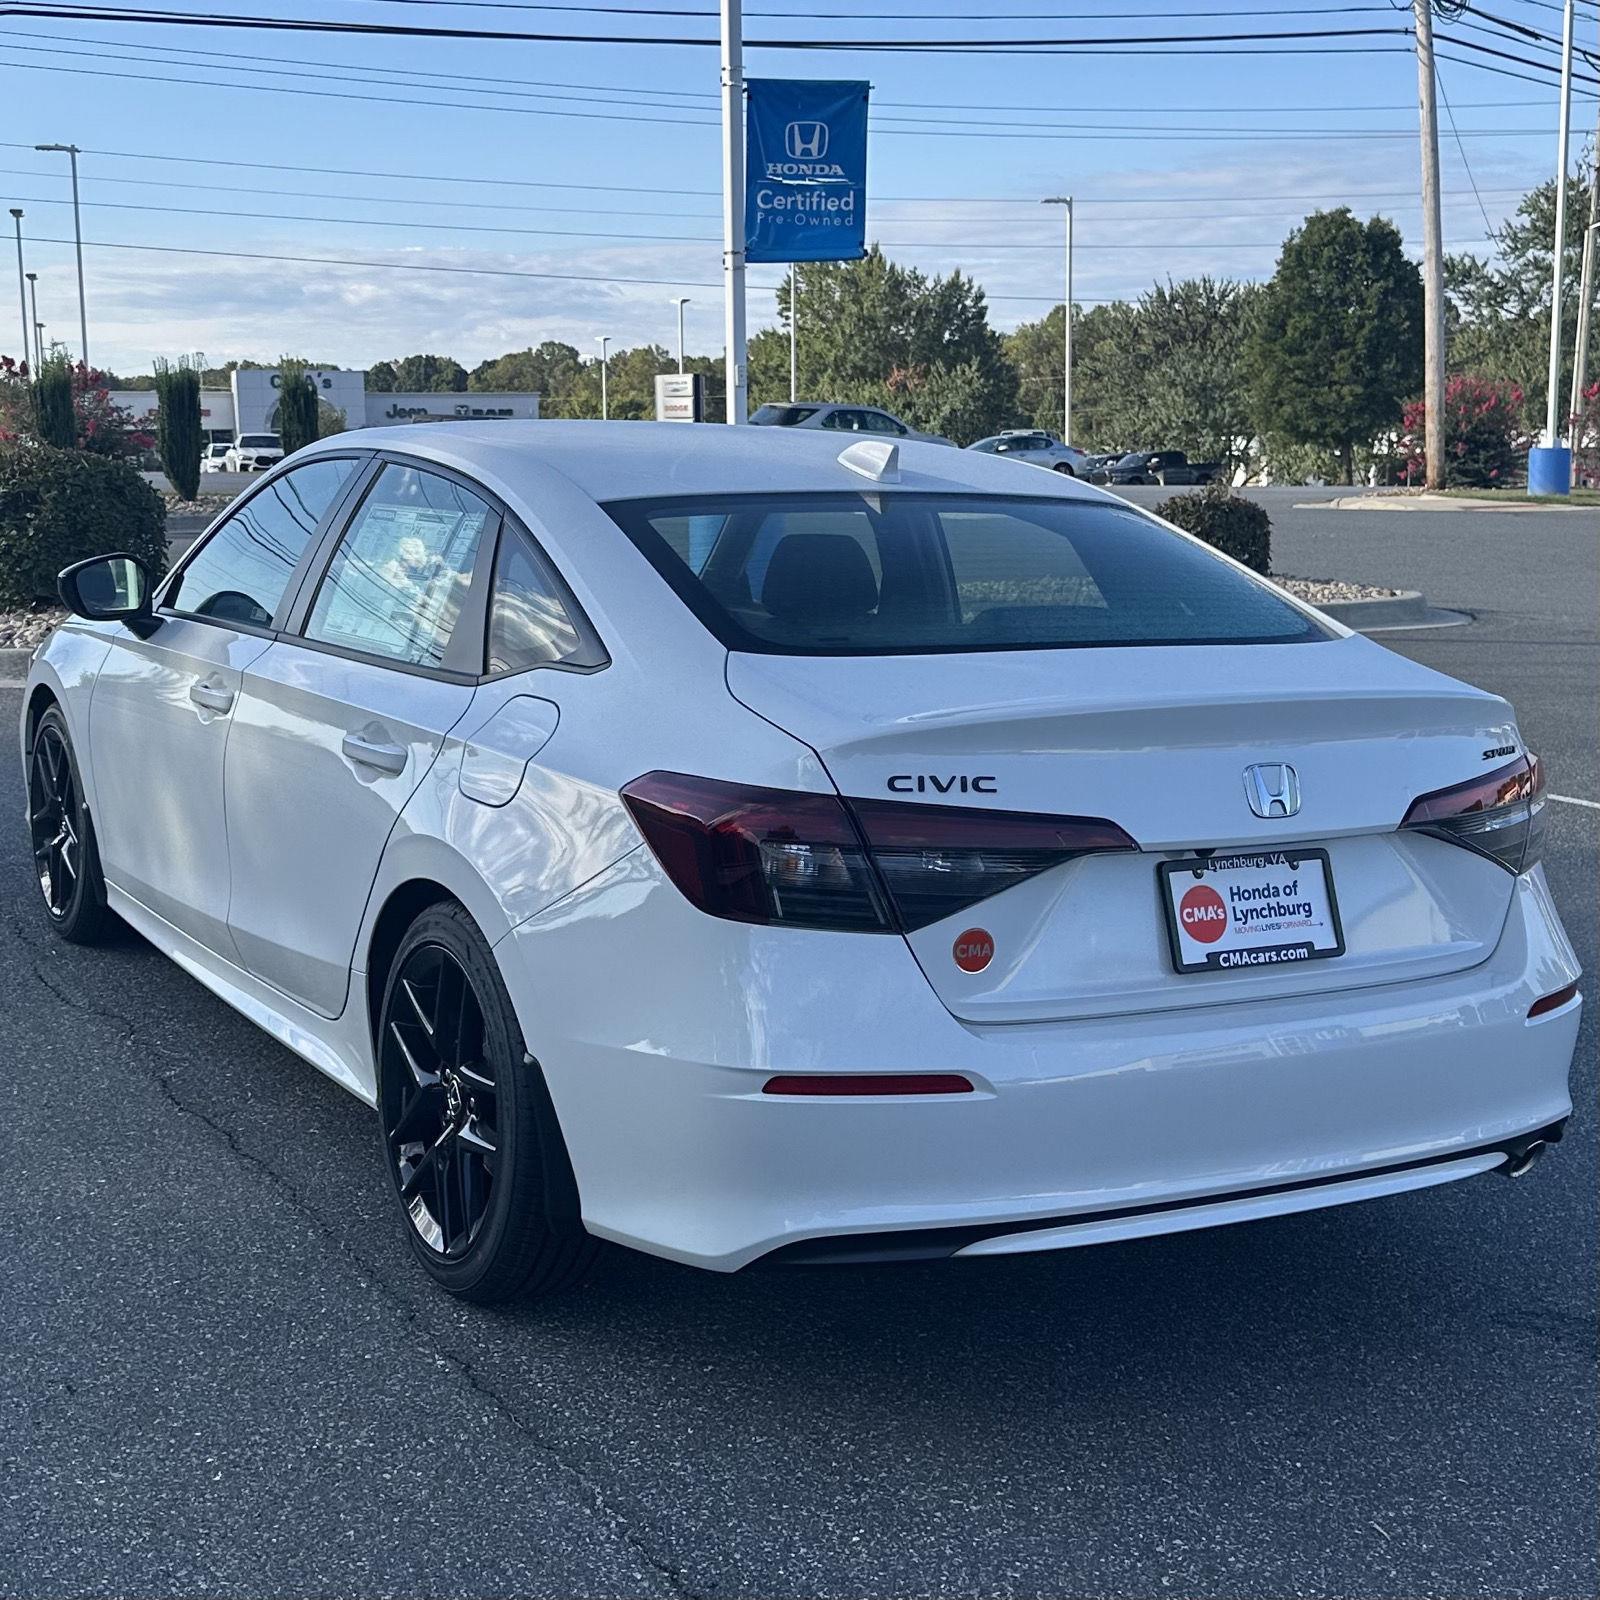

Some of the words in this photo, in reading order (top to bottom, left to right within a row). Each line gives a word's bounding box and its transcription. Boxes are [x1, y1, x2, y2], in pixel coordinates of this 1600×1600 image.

[766, 163, 845, 175] HONDA
[757, 190, 854, 211] Certified
[757, 213, 854, 226] Pre-Owned
[270, 372, 332, 389] CA's
[887, 775, 997, 793] CIVIC
[1270, 853, 1287, 865] VA
[1229, 883, 1280, 902] Honda
[1283, 880, 1298, 897] of
[1183, 905, 1225, 923] CMA's
[1232, 901, 1313, 925] Lynchburg
[956, 943, 991, 958] CMA
[1219, 947, 1308, 968] CMAcars.com
